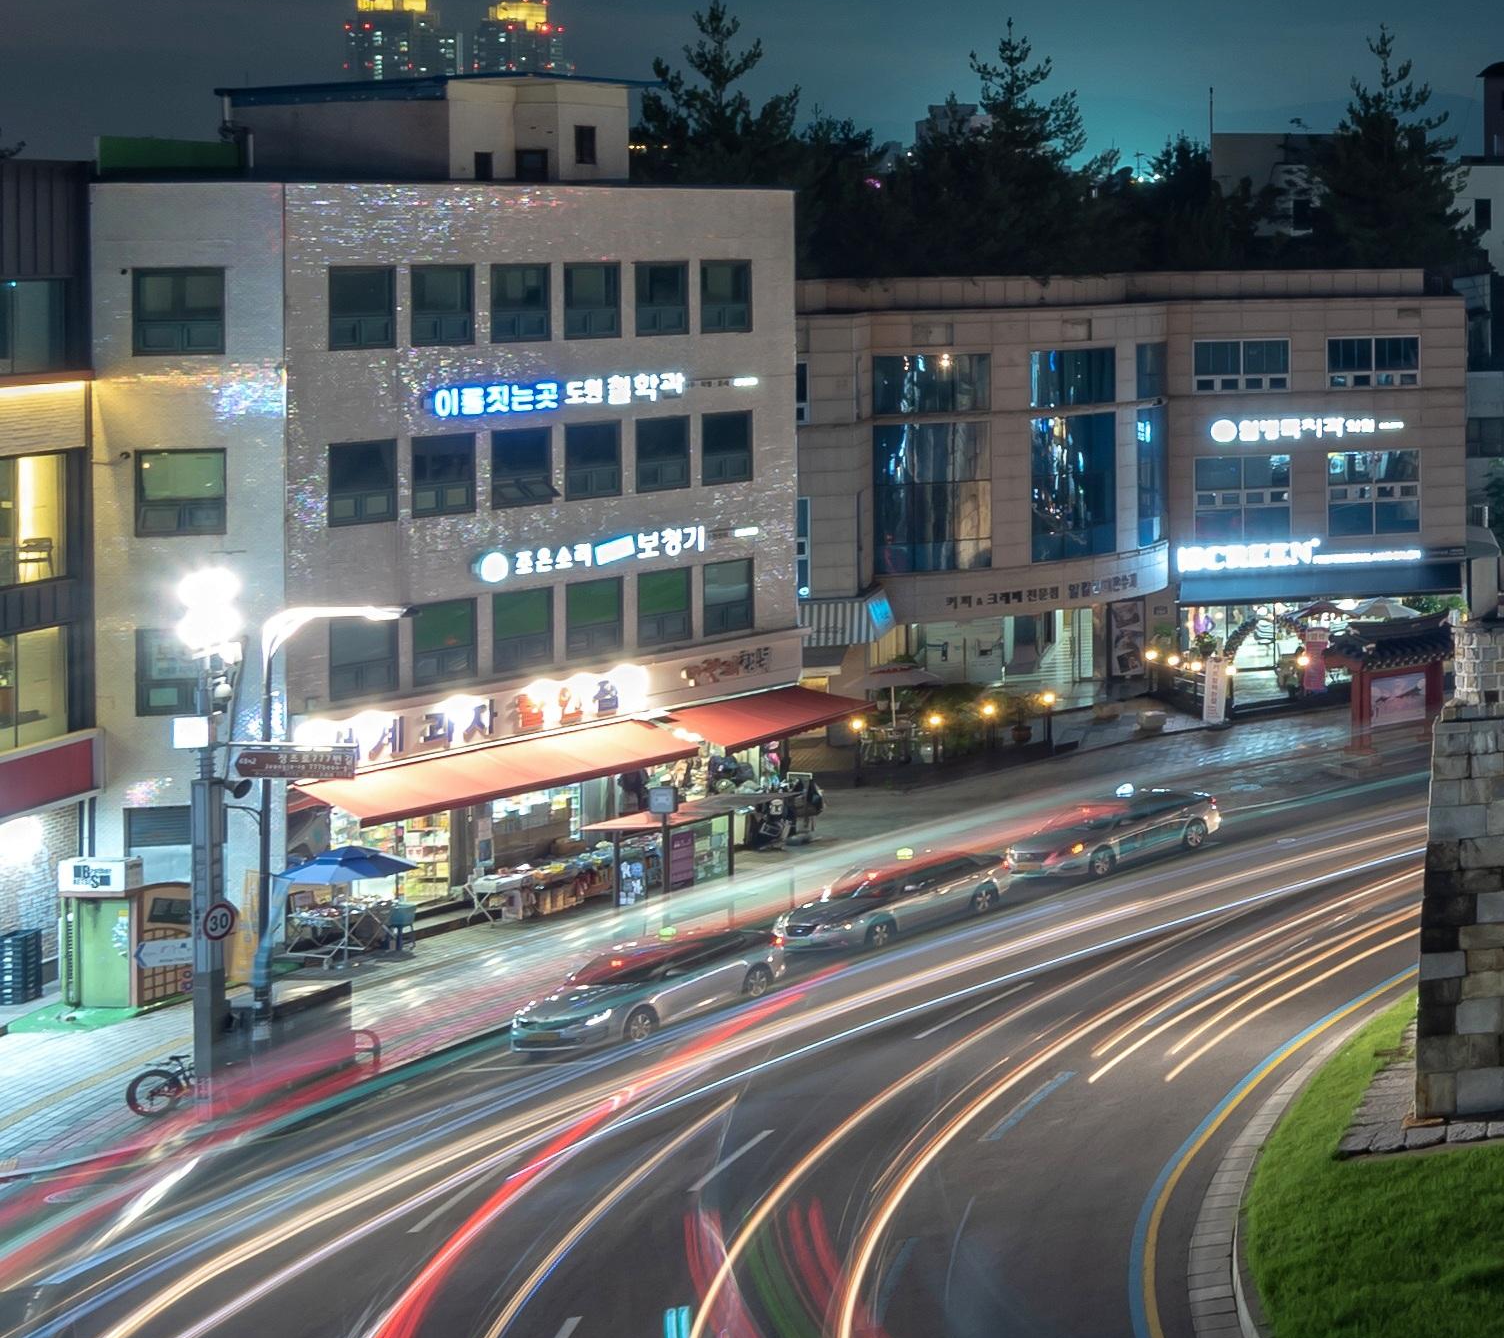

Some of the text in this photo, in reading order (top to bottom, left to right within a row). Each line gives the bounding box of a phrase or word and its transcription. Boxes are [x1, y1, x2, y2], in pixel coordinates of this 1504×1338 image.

[435, 380, 559, 417] 이름짓는곳
[637, 525, 705, 559] 보청기
[209, 912, 229, 931] 30
